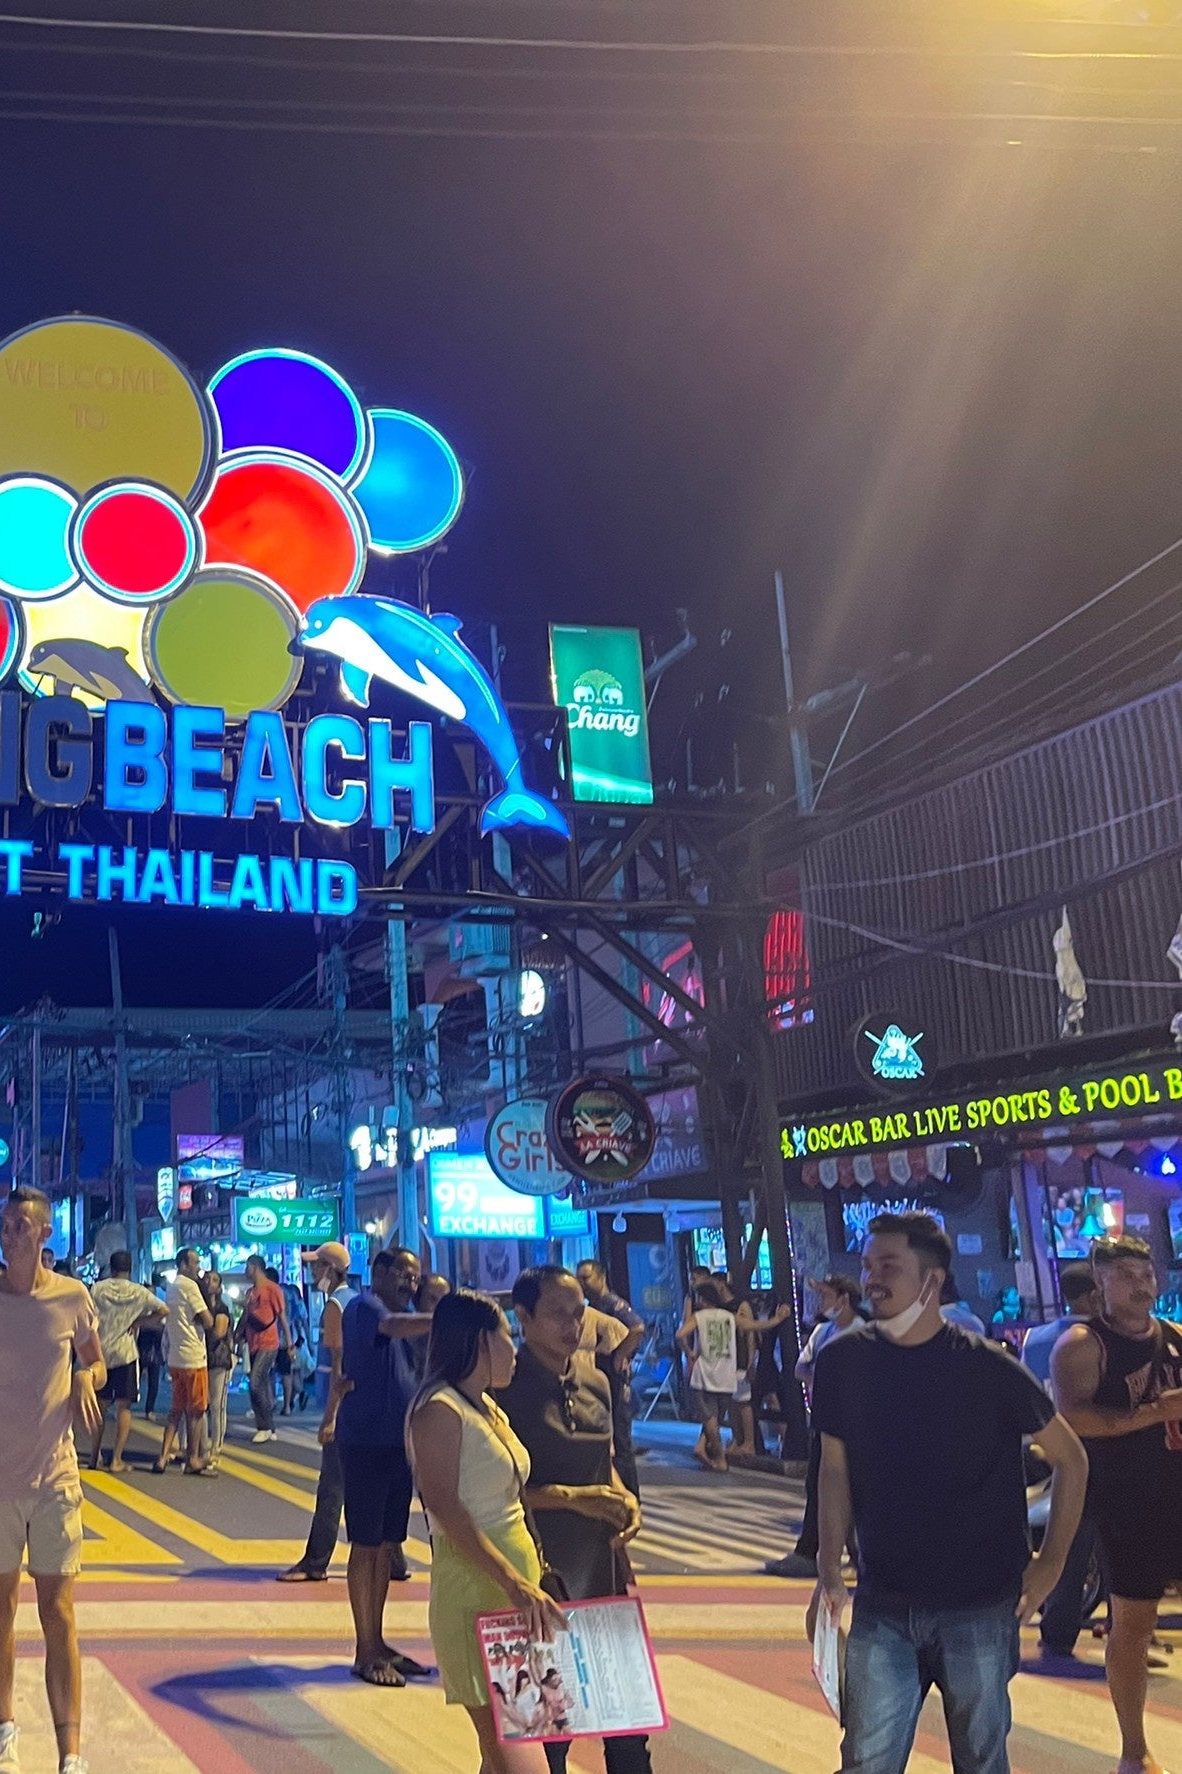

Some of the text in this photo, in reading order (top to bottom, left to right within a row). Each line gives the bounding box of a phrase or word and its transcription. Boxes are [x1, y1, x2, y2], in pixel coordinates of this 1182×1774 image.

[4, 357, 169, 396] WELCOME
[69, 403, 109, 431] TO
[567, 703, 641, 737] Chang
[102, 699, 435, 833] BEACH
[59, 843, 358, 915] THAILAND
[807, 1119, 868, 1153] OSCAR
[869, 1113, 911, 1143] BAR
[914, 1104, 962, 1136] LIVE
[966, 1088, 1053, 1130] SPORTS
[1058, 1084, 1082, 1115] &
[1082, 1071, 1160, 1113] POOL
[496, 1121, 548, 1148] Cra
[650, 1145, 702, 1173] CHIAVE
[435, 1181, 478, 1214] 99
[281, 1213, 334, 1228] 1112
[439, 1216, 538, 1236] EXCHANGE
[550, 1209, 586, 1226] EXCHANGE
